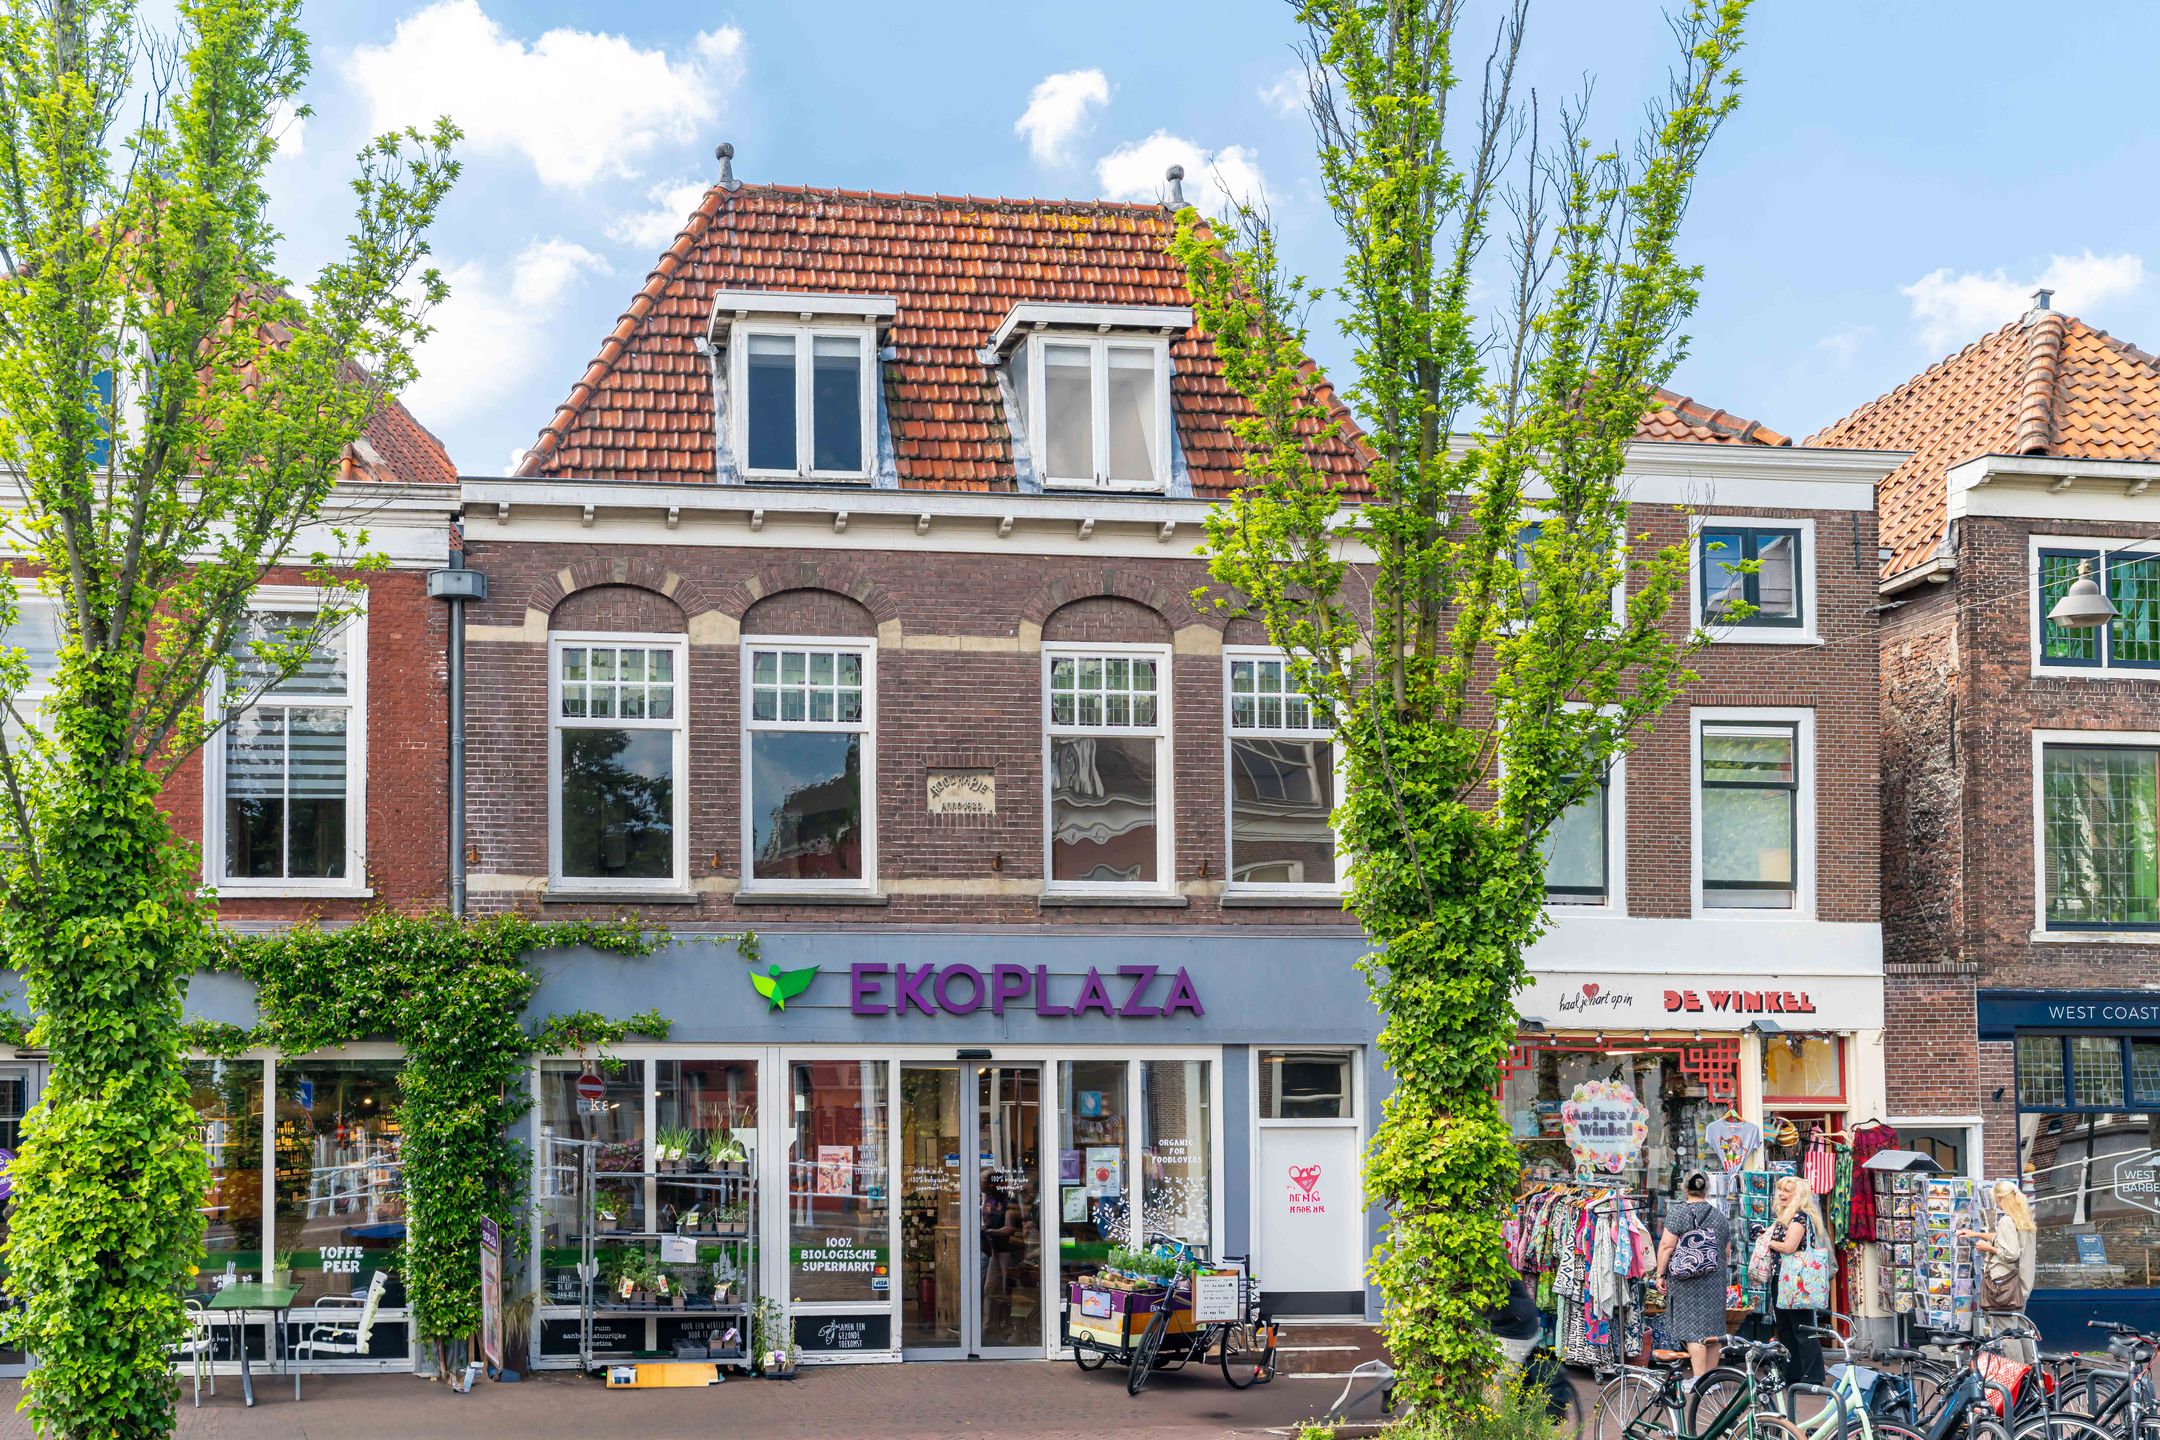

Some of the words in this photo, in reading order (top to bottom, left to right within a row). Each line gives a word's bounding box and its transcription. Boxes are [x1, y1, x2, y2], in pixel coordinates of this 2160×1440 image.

[850, 962, 1206, 1016] EKOPLAZA
[1559, 992, 1579, 1012] haal
[1588, 988, 1609, 1006] hart
[1611, 994, 1623, 1010] op
[1622, 993, 1634, 1007] in
[1664, 990, 1704, 1013] DE
[1706, 990, 1817, 1014] WINKEL
[2048, 1006, 2096, 1019] WEST
[2102, 1006, 2160, 1020] COAST
[1573, 1106, 1639, 1121] Andrea's
[1578, 1121, 1634, 1137] Winkel
[1158, 1139, 1193, 1147] ORGANIC
[1169, 1147, 1185, 1155] FOR
[2123, 1170, 2157, 1180] WEST
[826, 1237, 852, 1248] 100%
[319, 1246, 364, 1259] TOFFE
[800, 1249, 877, 1260] BIOLOGISCHE
[322, 1260, 360, 1274] PEER
[802, 1261, 876, 1272] SUPERMARKT
[838, 1322, 855, 1331] SAMEN
[856, 1322, 866, 1331] EEN
[838, 1331, 861, 1340] GEZONDE
[838, 1339, 863, 1349] TOEKOMST
